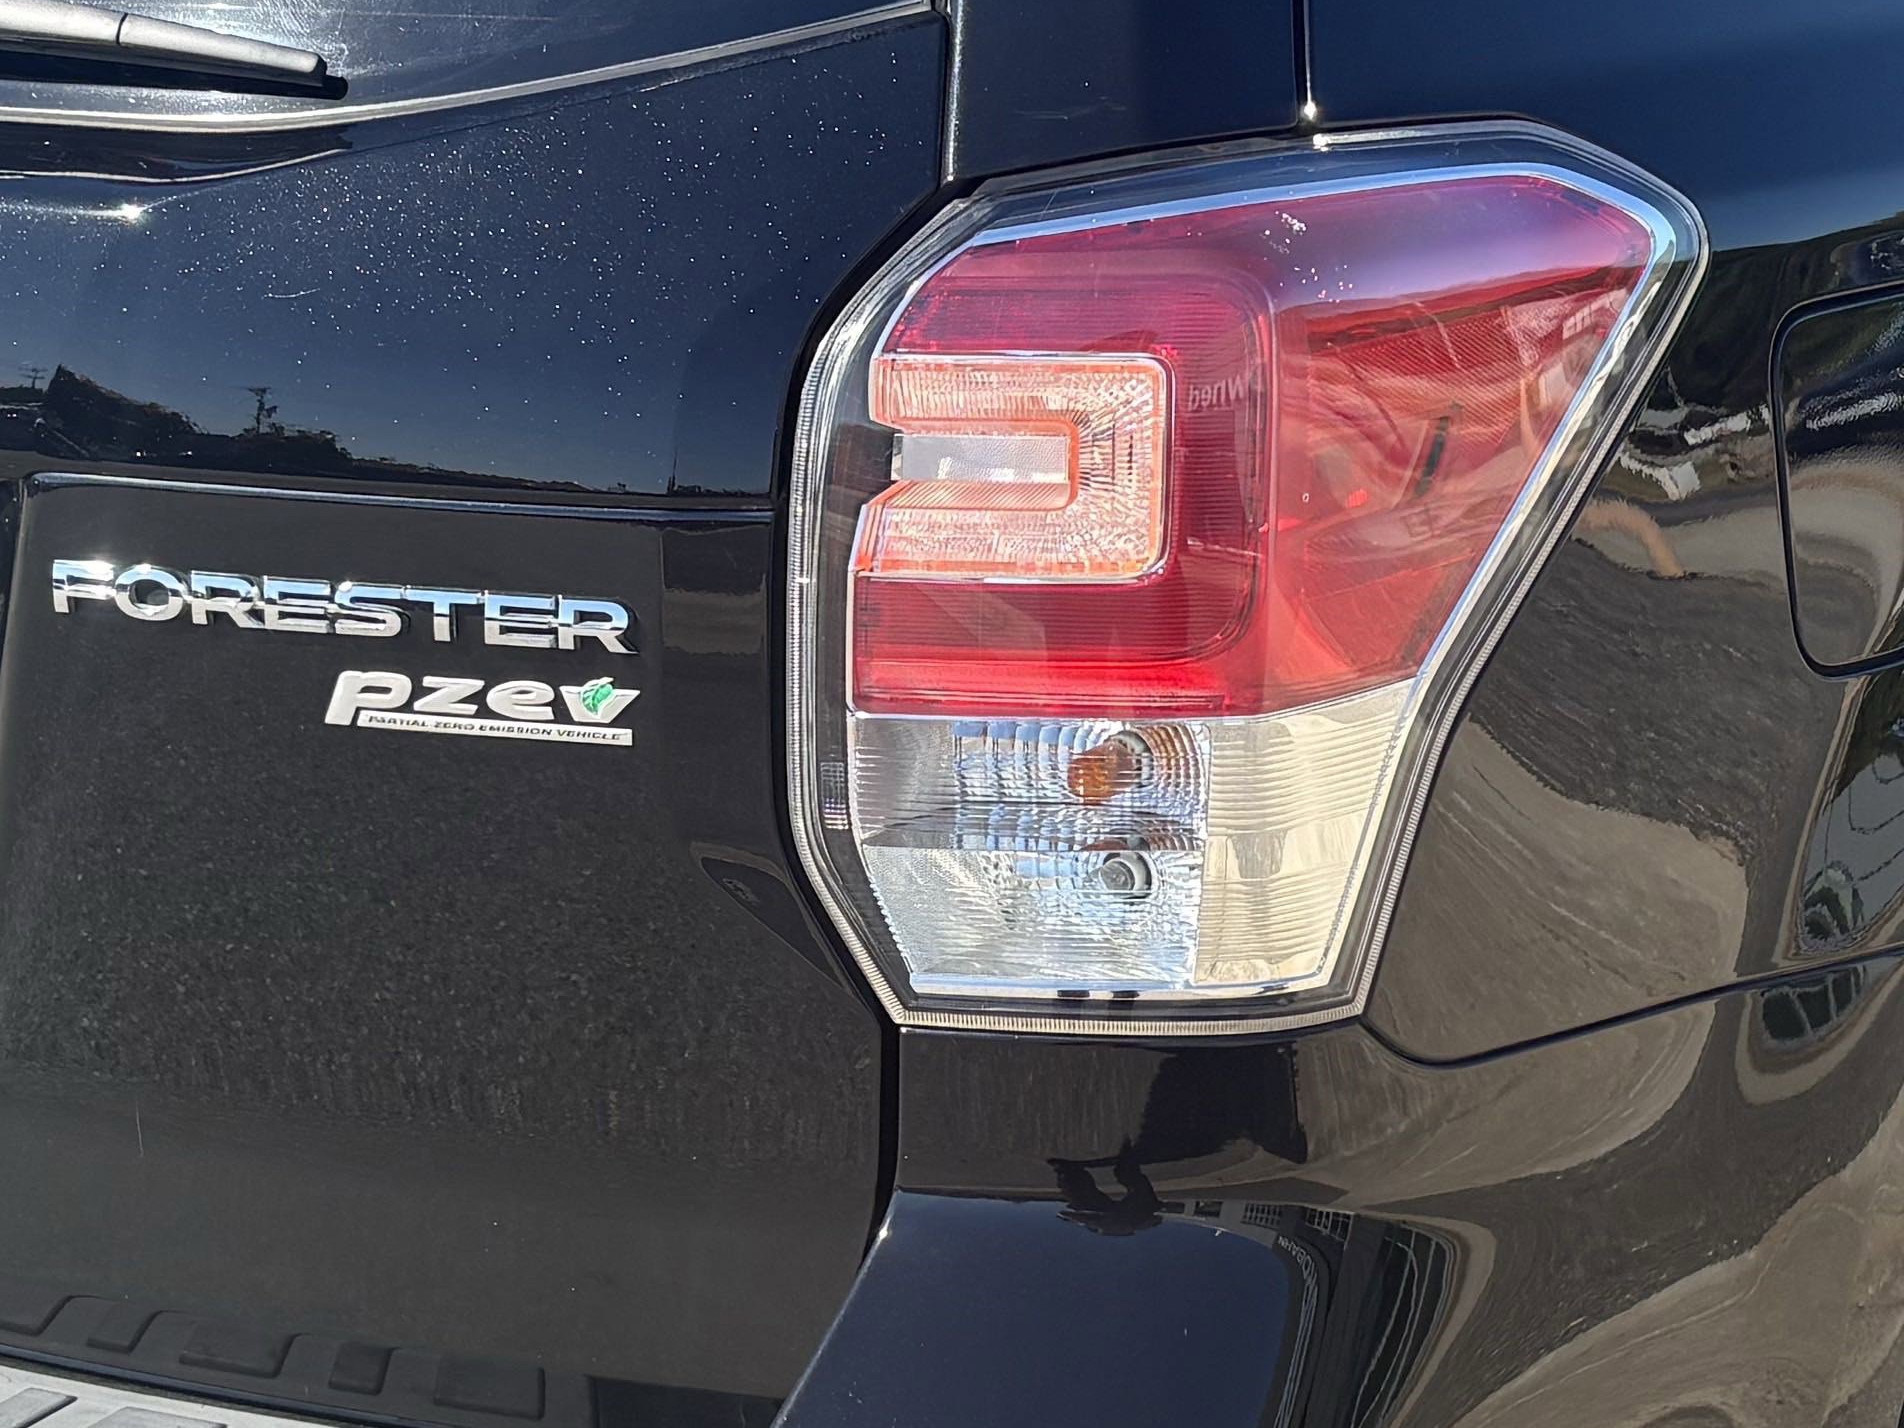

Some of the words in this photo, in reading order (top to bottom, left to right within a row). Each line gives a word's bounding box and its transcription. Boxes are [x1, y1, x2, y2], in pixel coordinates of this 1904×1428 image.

[52, 559, 639, 654] FORESTER
[324, 670, 641, 725] pzev
[366, 714, 428, 728] PARTIAL
[432, 720, 476, 732] ZERO
[478, 724, 553, 737] EMISSION
[556, 728, 622, 741] VEHICLE
